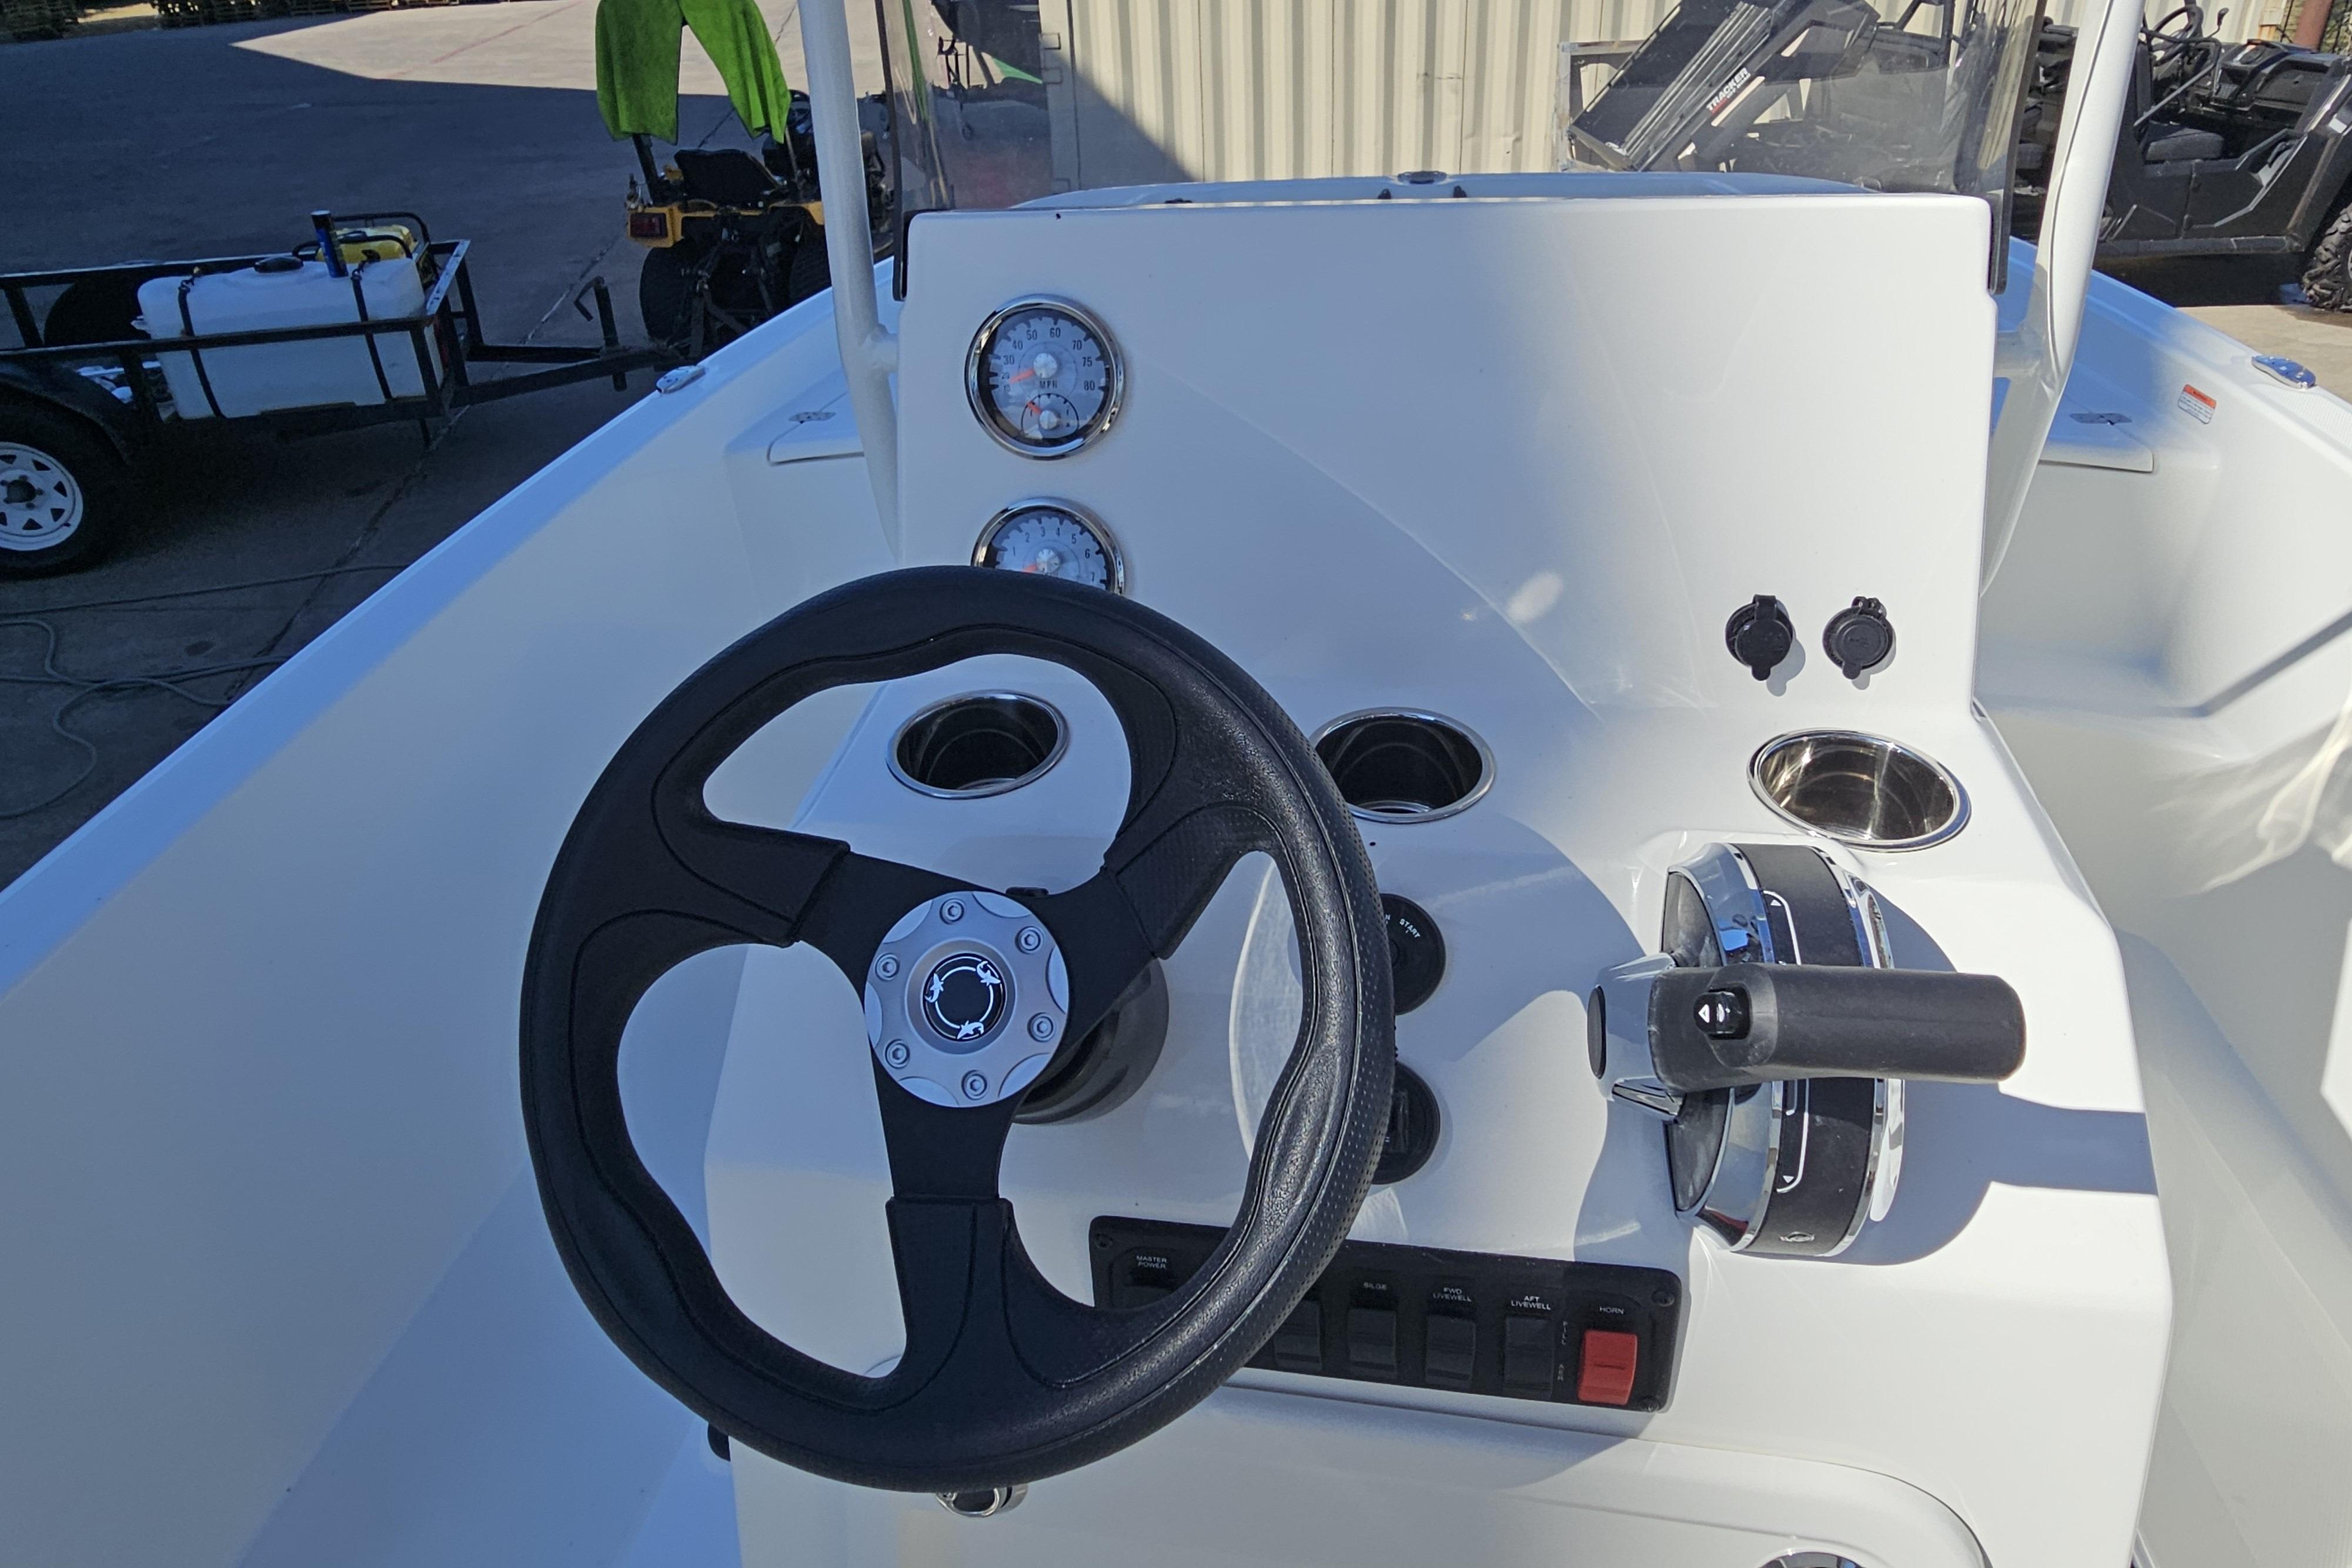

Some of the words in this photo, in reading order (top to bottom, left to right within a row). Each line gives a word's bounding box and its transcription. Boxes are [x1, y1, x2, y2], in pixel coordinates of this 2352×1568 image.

[1706, 68, 1748, 111] TRACKER
[1026, 329, 1037, 340] 50
[1050, 327, 1061, 338] 60
[1012, 340, 1023, 350] 40
[1073, 340, 1083, 350] 70
[1003, 355, 1015, 365] 30
[1082, 356, 1093, 367] 75
[1040, 381, 1057, 389] MPH
[1084, 380, 1095, 390] 80
[1041, 526, 1045, 537] 3
[1055, 527, 1060, 536] 4
[1025, 532, 1030, 543] 2
[1071, 533, 1077, 544] 5
[1013, 546, 1015, 556] 1
[1085, 549, 1090, 559] 6
[1091, 571, 1095, 582] 7
[1399, 918, 1421, 938] START
[1136, 1255, 1167, 1263] MASTER
[1138, 1261, 1167, 1269] POWER
[1432, 1293, 1472, 1302] LIVEWELL
[1511, 1300, 1551, 1310] LIVEWELL
[1599, 1306, 1624, 1315] HORN
